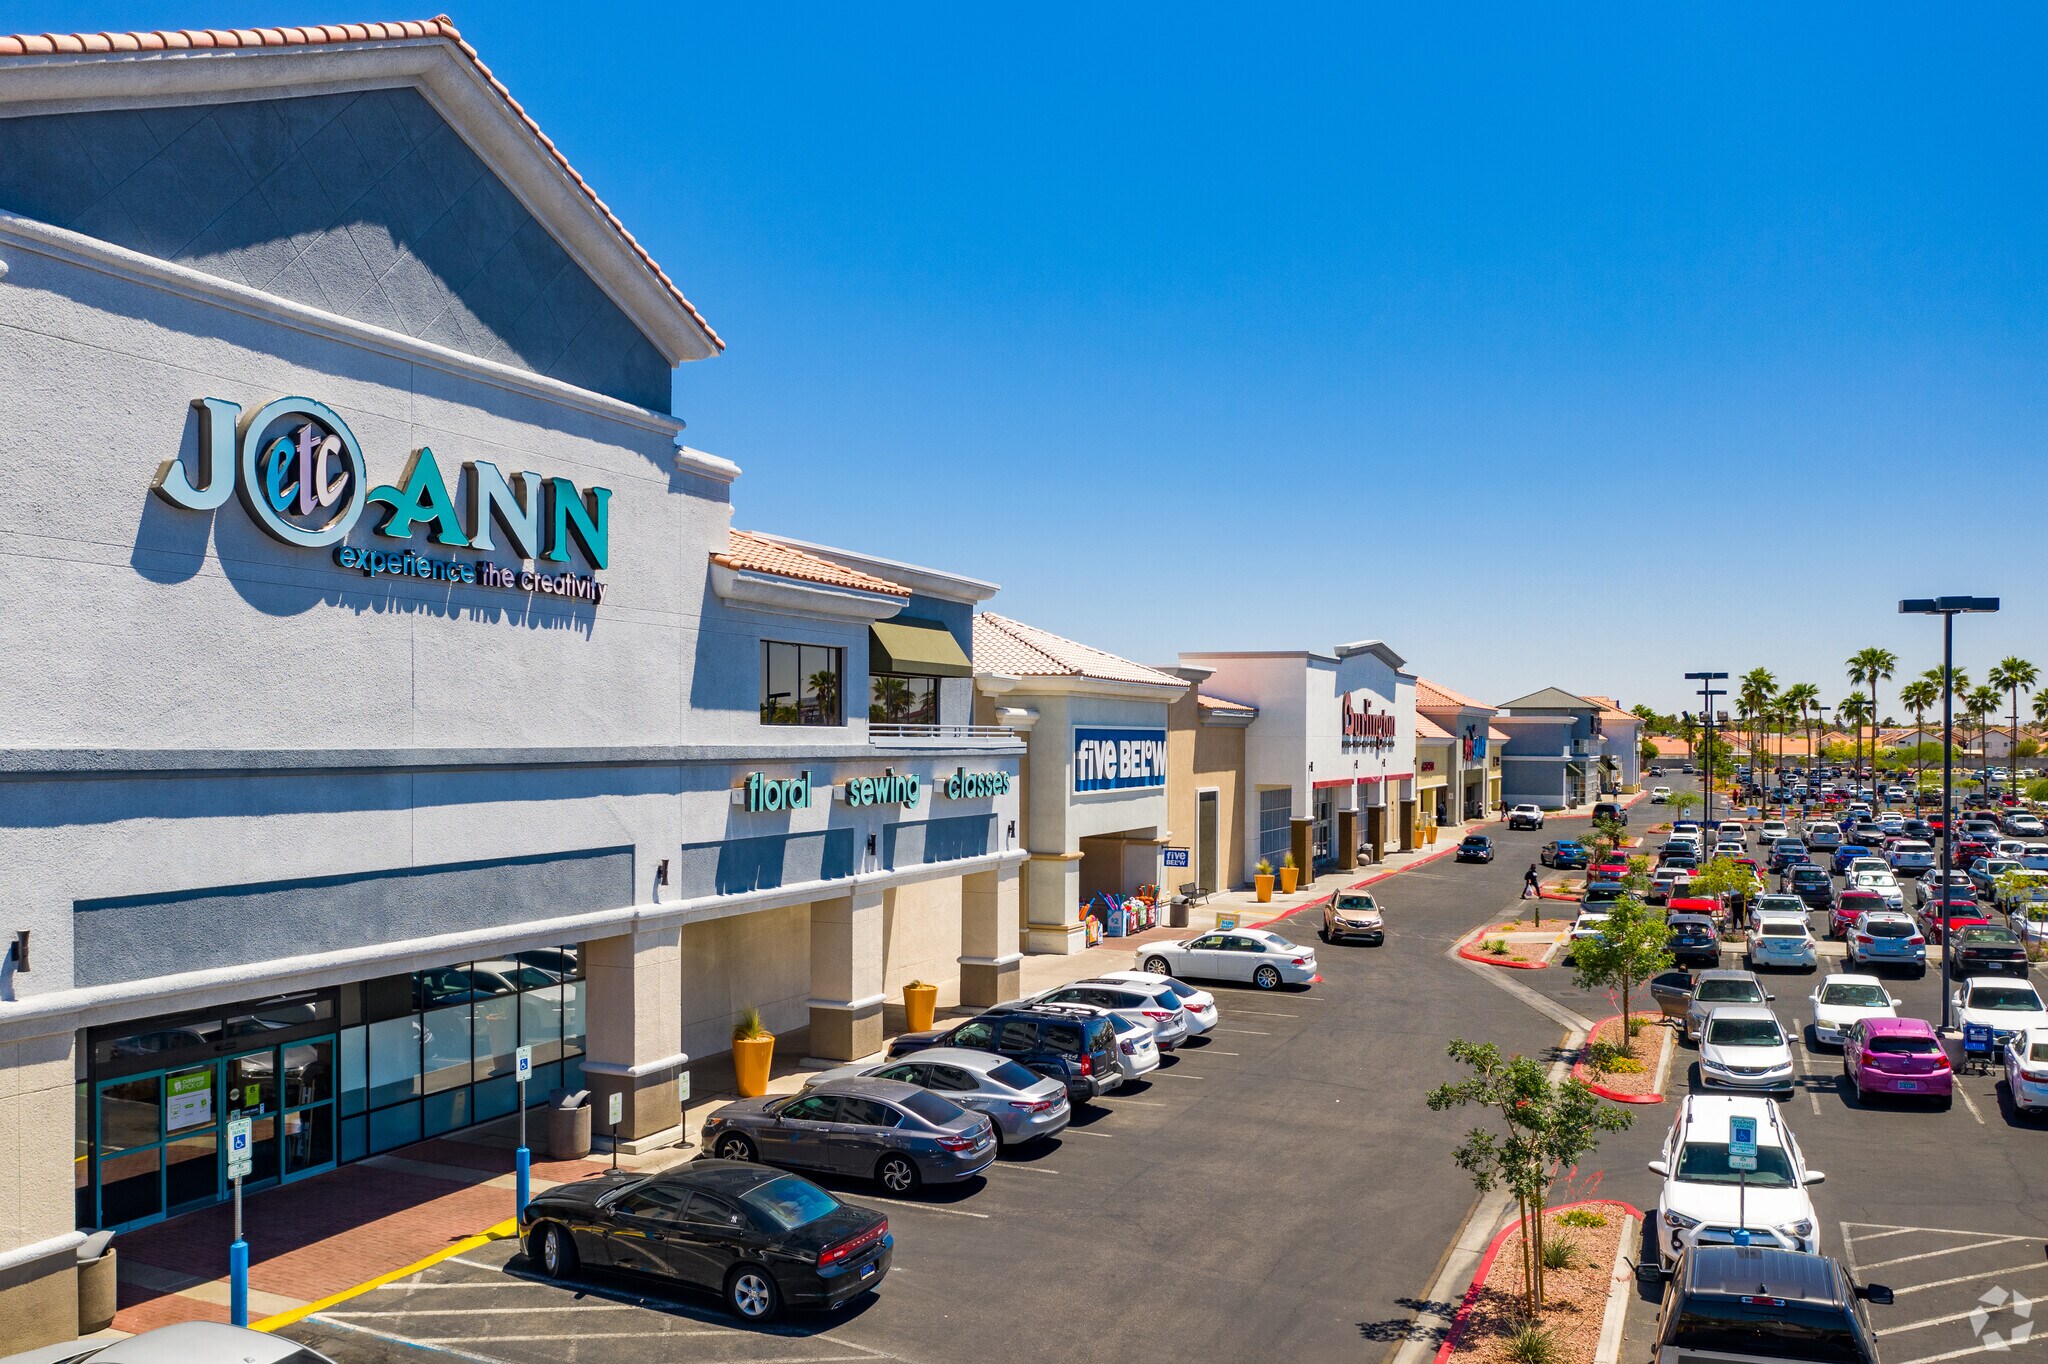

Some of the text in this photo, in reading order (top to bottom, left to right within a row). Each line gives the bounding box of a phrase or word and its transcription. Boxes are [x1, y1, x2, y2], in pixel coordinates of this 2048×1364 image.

[261, 423, 349, 516] etc
[333, 546, 608, 605] experience the creativity
[1342, 691, 1396, 750] Burlington
[1077, 739, 1117, 781] five
[745, 766, 1011, 812] floral sewing classes
[1167, 851, 1186, 860] five
[182, 1080, 205, 1090] PICK-UP
